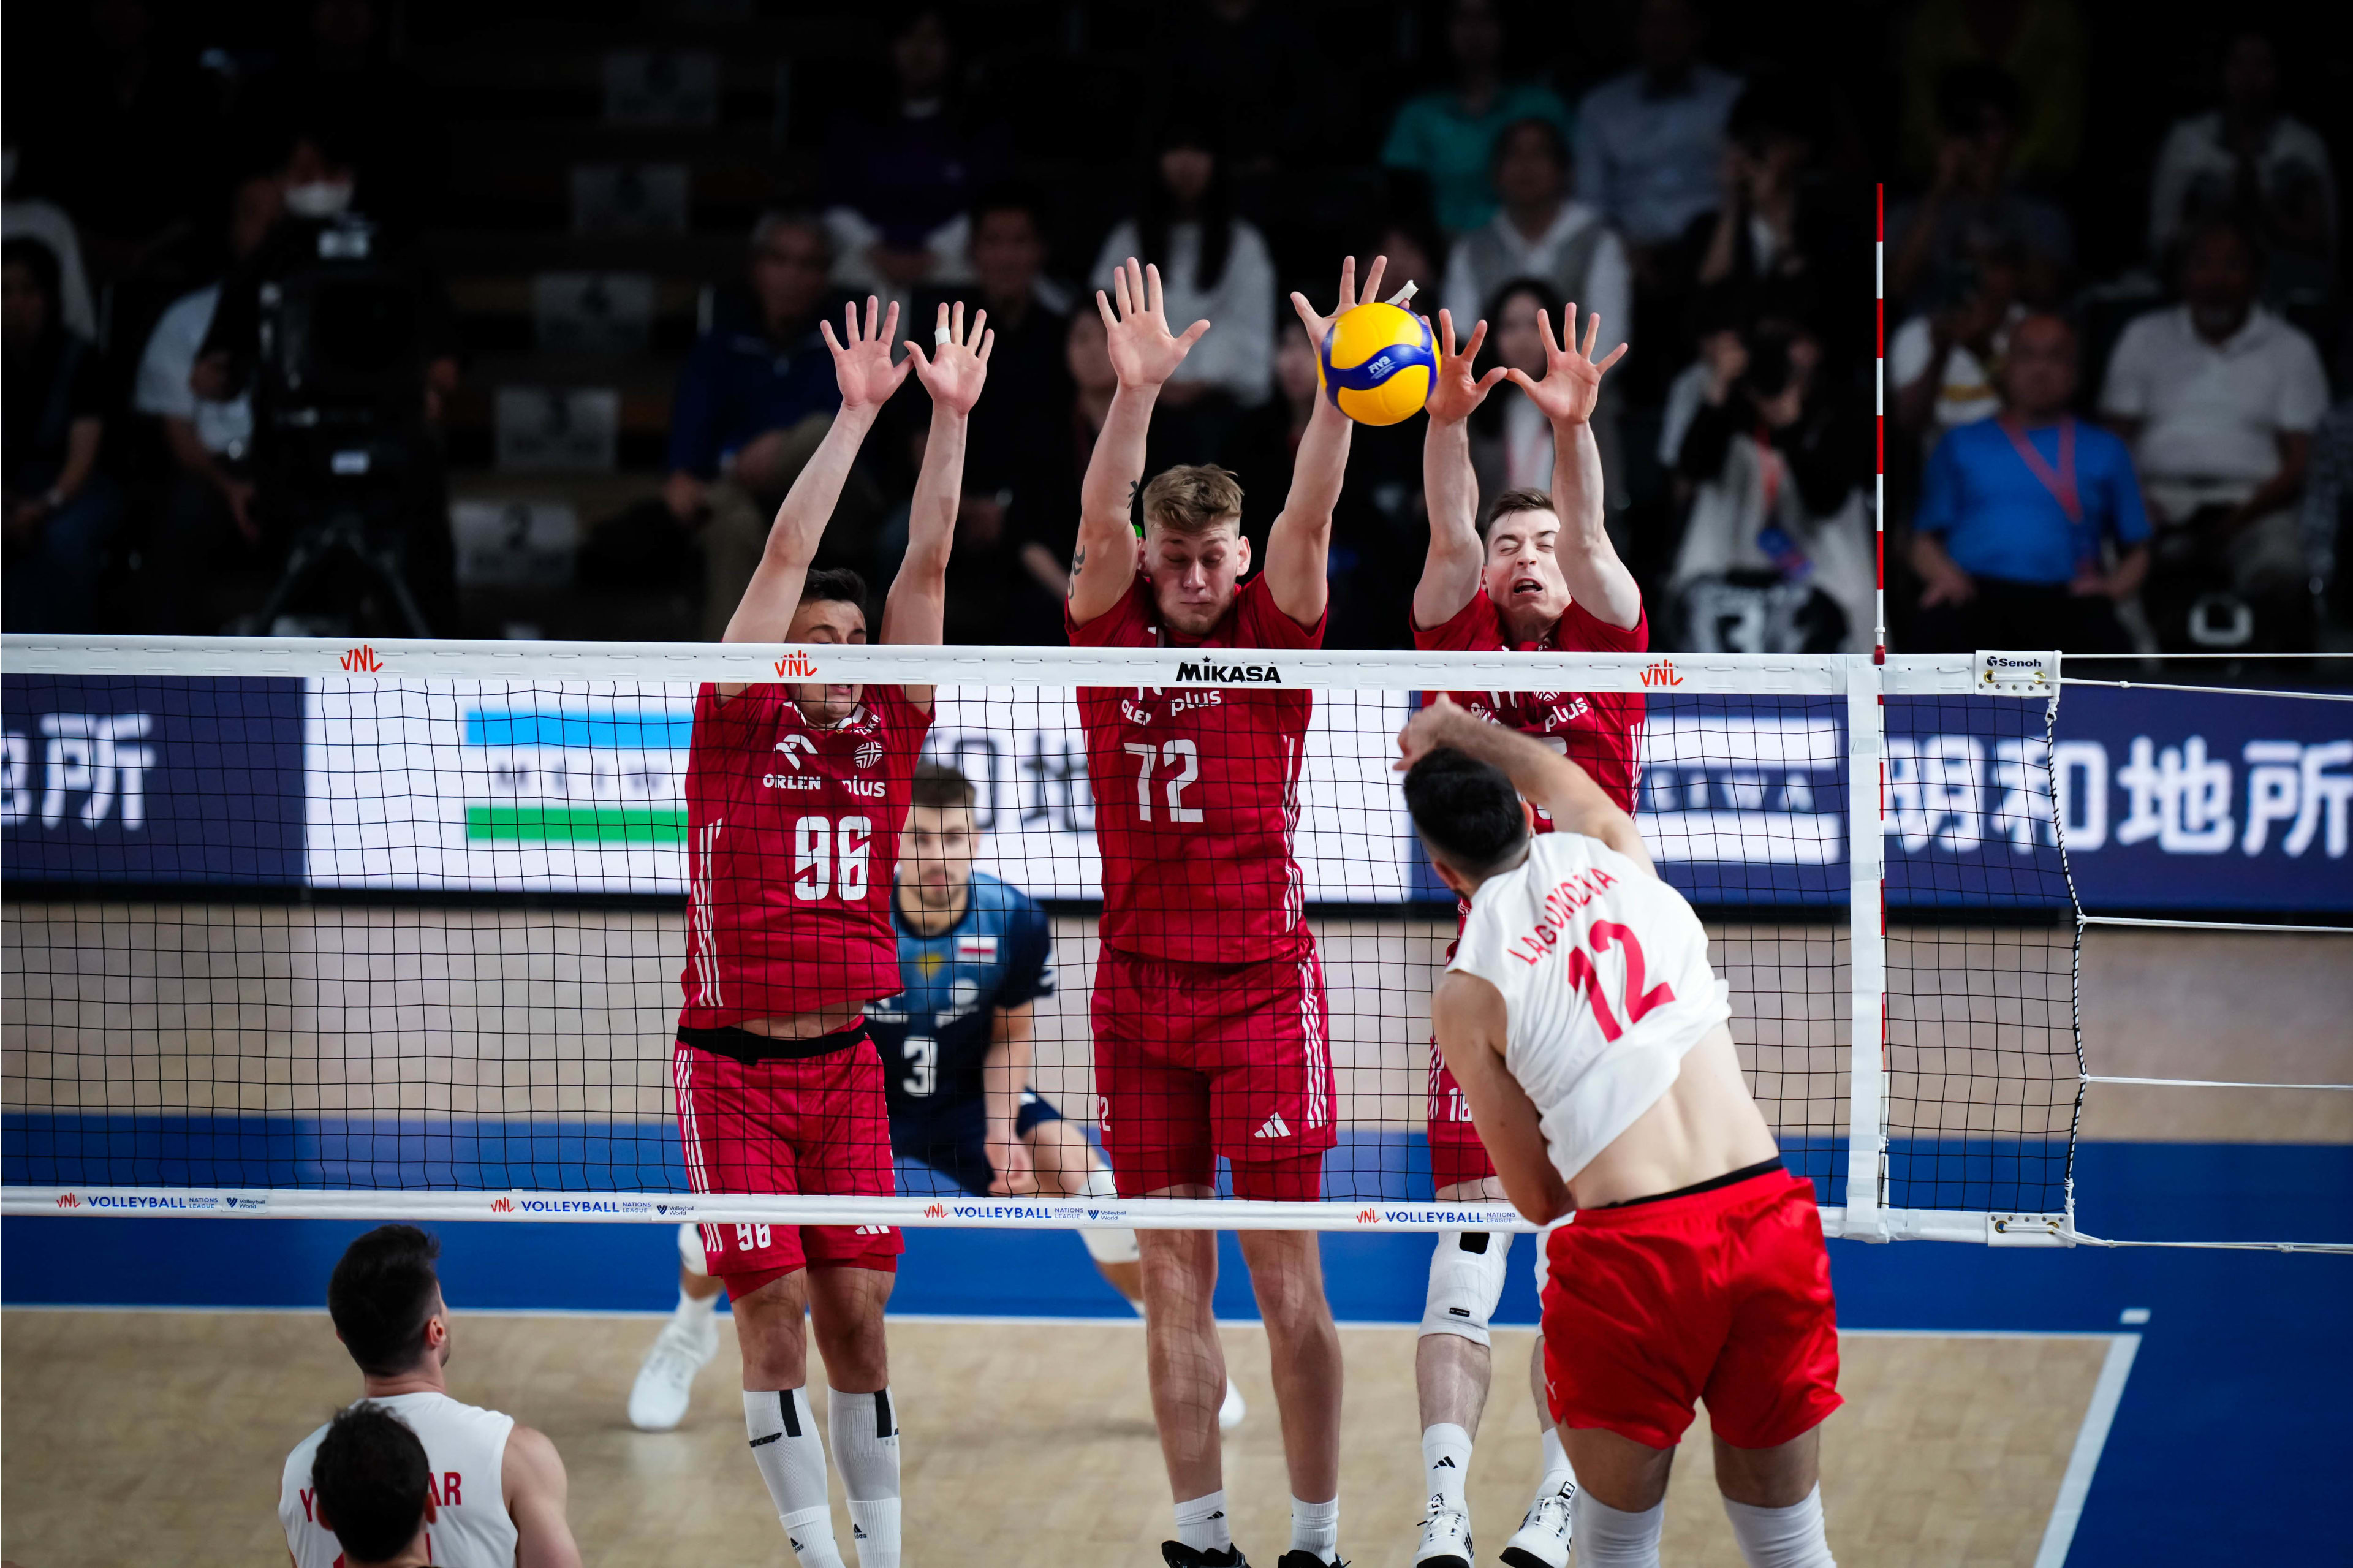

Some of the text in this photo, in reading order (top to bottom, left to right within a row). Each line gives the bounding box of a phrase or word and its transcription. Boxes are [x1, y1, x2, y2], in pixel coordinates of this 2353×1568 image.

[340, 645, 384, 673] VNL
[775, 650, 817, 678] VNL
[1175, 659, 1282, 683] MIKASA
[1640, 659, 1683, 687] VNL
[1999, 658, 2042, 667] Senoh
[1171, 690, 1221, 716] plus
[1545, 697, 1588, 732] plus
[0, 711, 156, 831] 所
[763, 773, 821, 790] ORLEN
[1124, 739, 1203, 823] 72
[1646, 770, 1816, 812] EIWA
[1882, 733, 2353, 857] 明和地所
[795, 816, 871, 901] 96
[1568, 919, 1676, 1043] 12
[902, 1035, 938, 1097] 3
[1097, 1096, 1111, 1132] 2
[56, 1192, 81, 1208] VNL
[88, 1196, 186, 1208] VOLLEYBALL
[491, 1197, 515, 1213] VNL
[521, 1200, 620, 1213] VOLLEYBALL
[924, 1203, 949, 1218] VNL
[953, 1206, 1052, 1219] VOLLEYBALL
[1356, 1208, 1381, 1224] VNL
[1385, 1211, 1484, 1224] VOLLEYBALL
